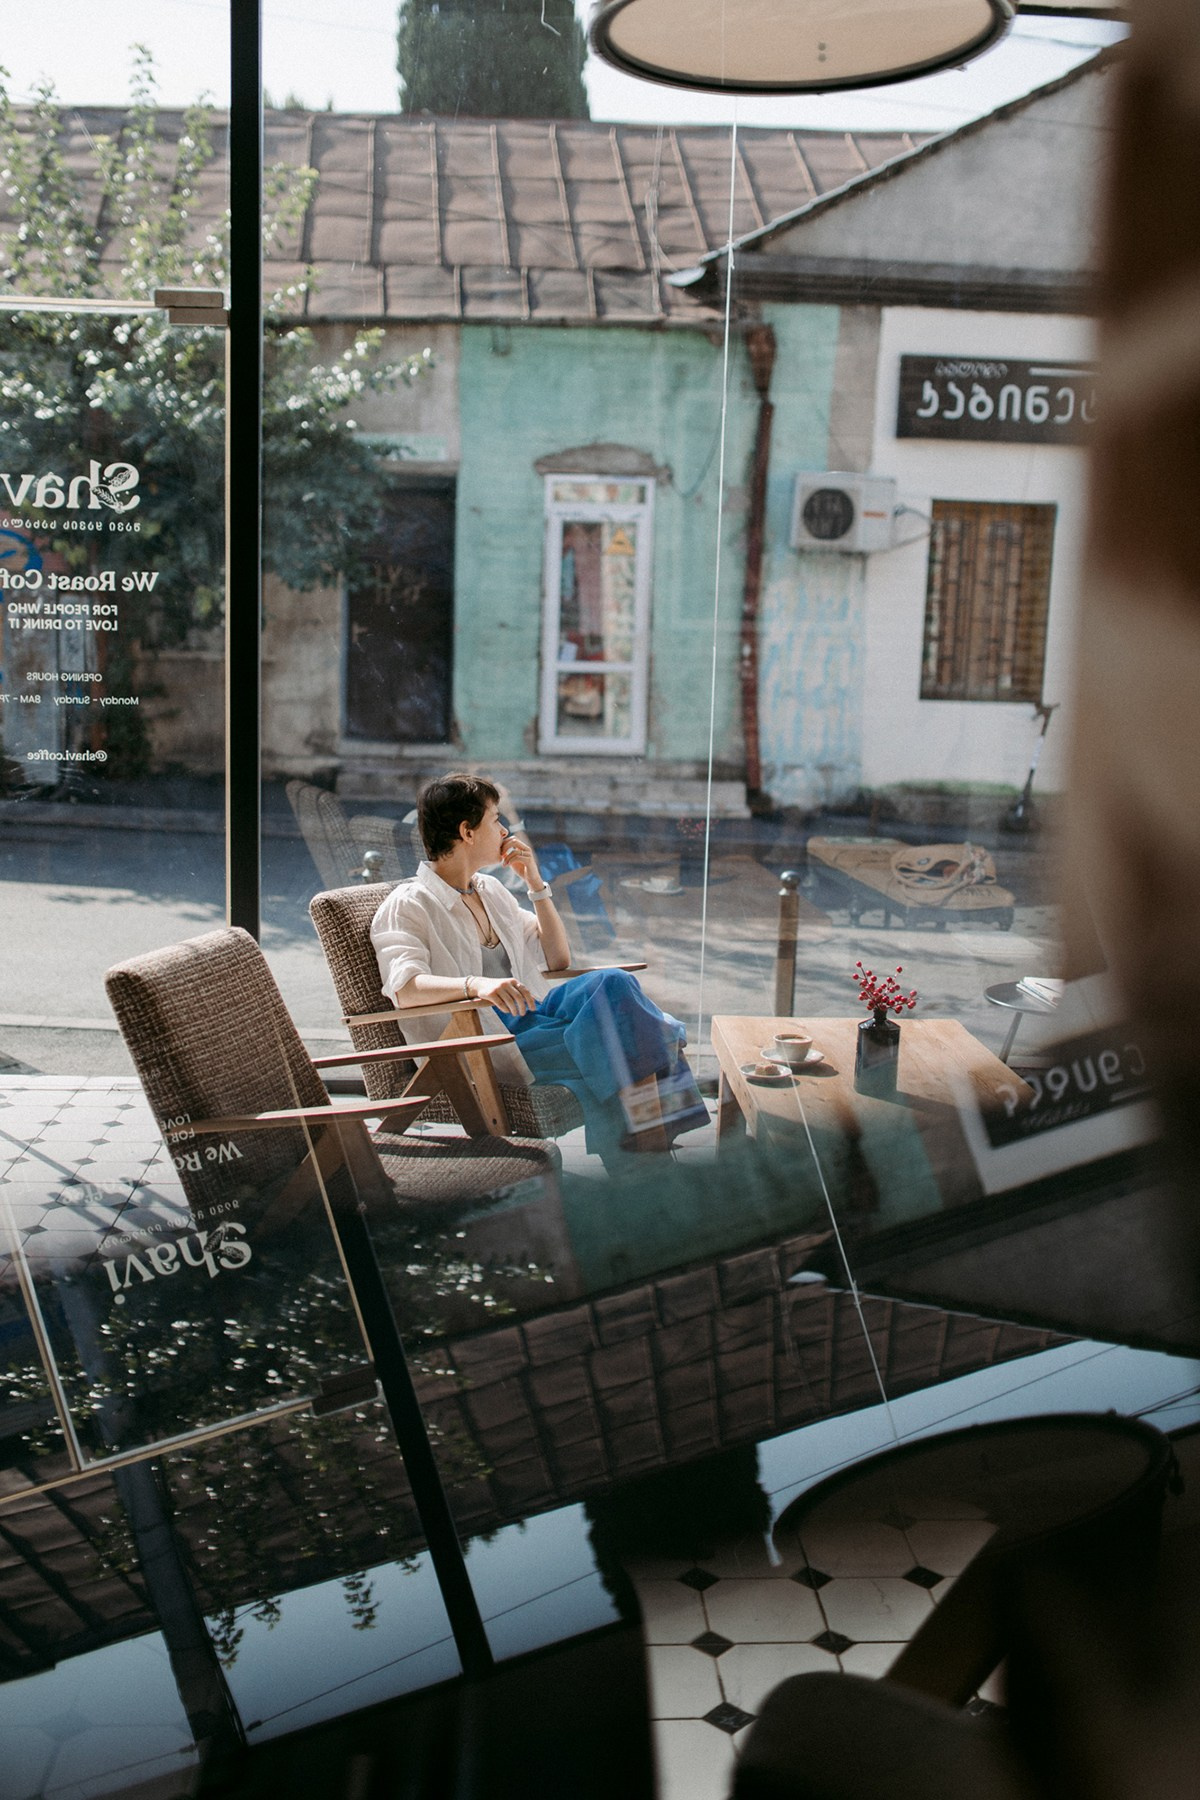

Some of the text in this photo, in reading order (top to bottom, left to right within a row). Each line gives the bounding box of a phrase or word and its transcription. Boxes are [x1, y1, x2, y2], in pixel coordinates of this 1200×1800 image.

[159, 1112, 192, 1132] LOVE
[170, 1128, 196, 1144] FOR
[204, 1141, 245, 1165] We
[102, 1221, 253, 1306] Shavi
